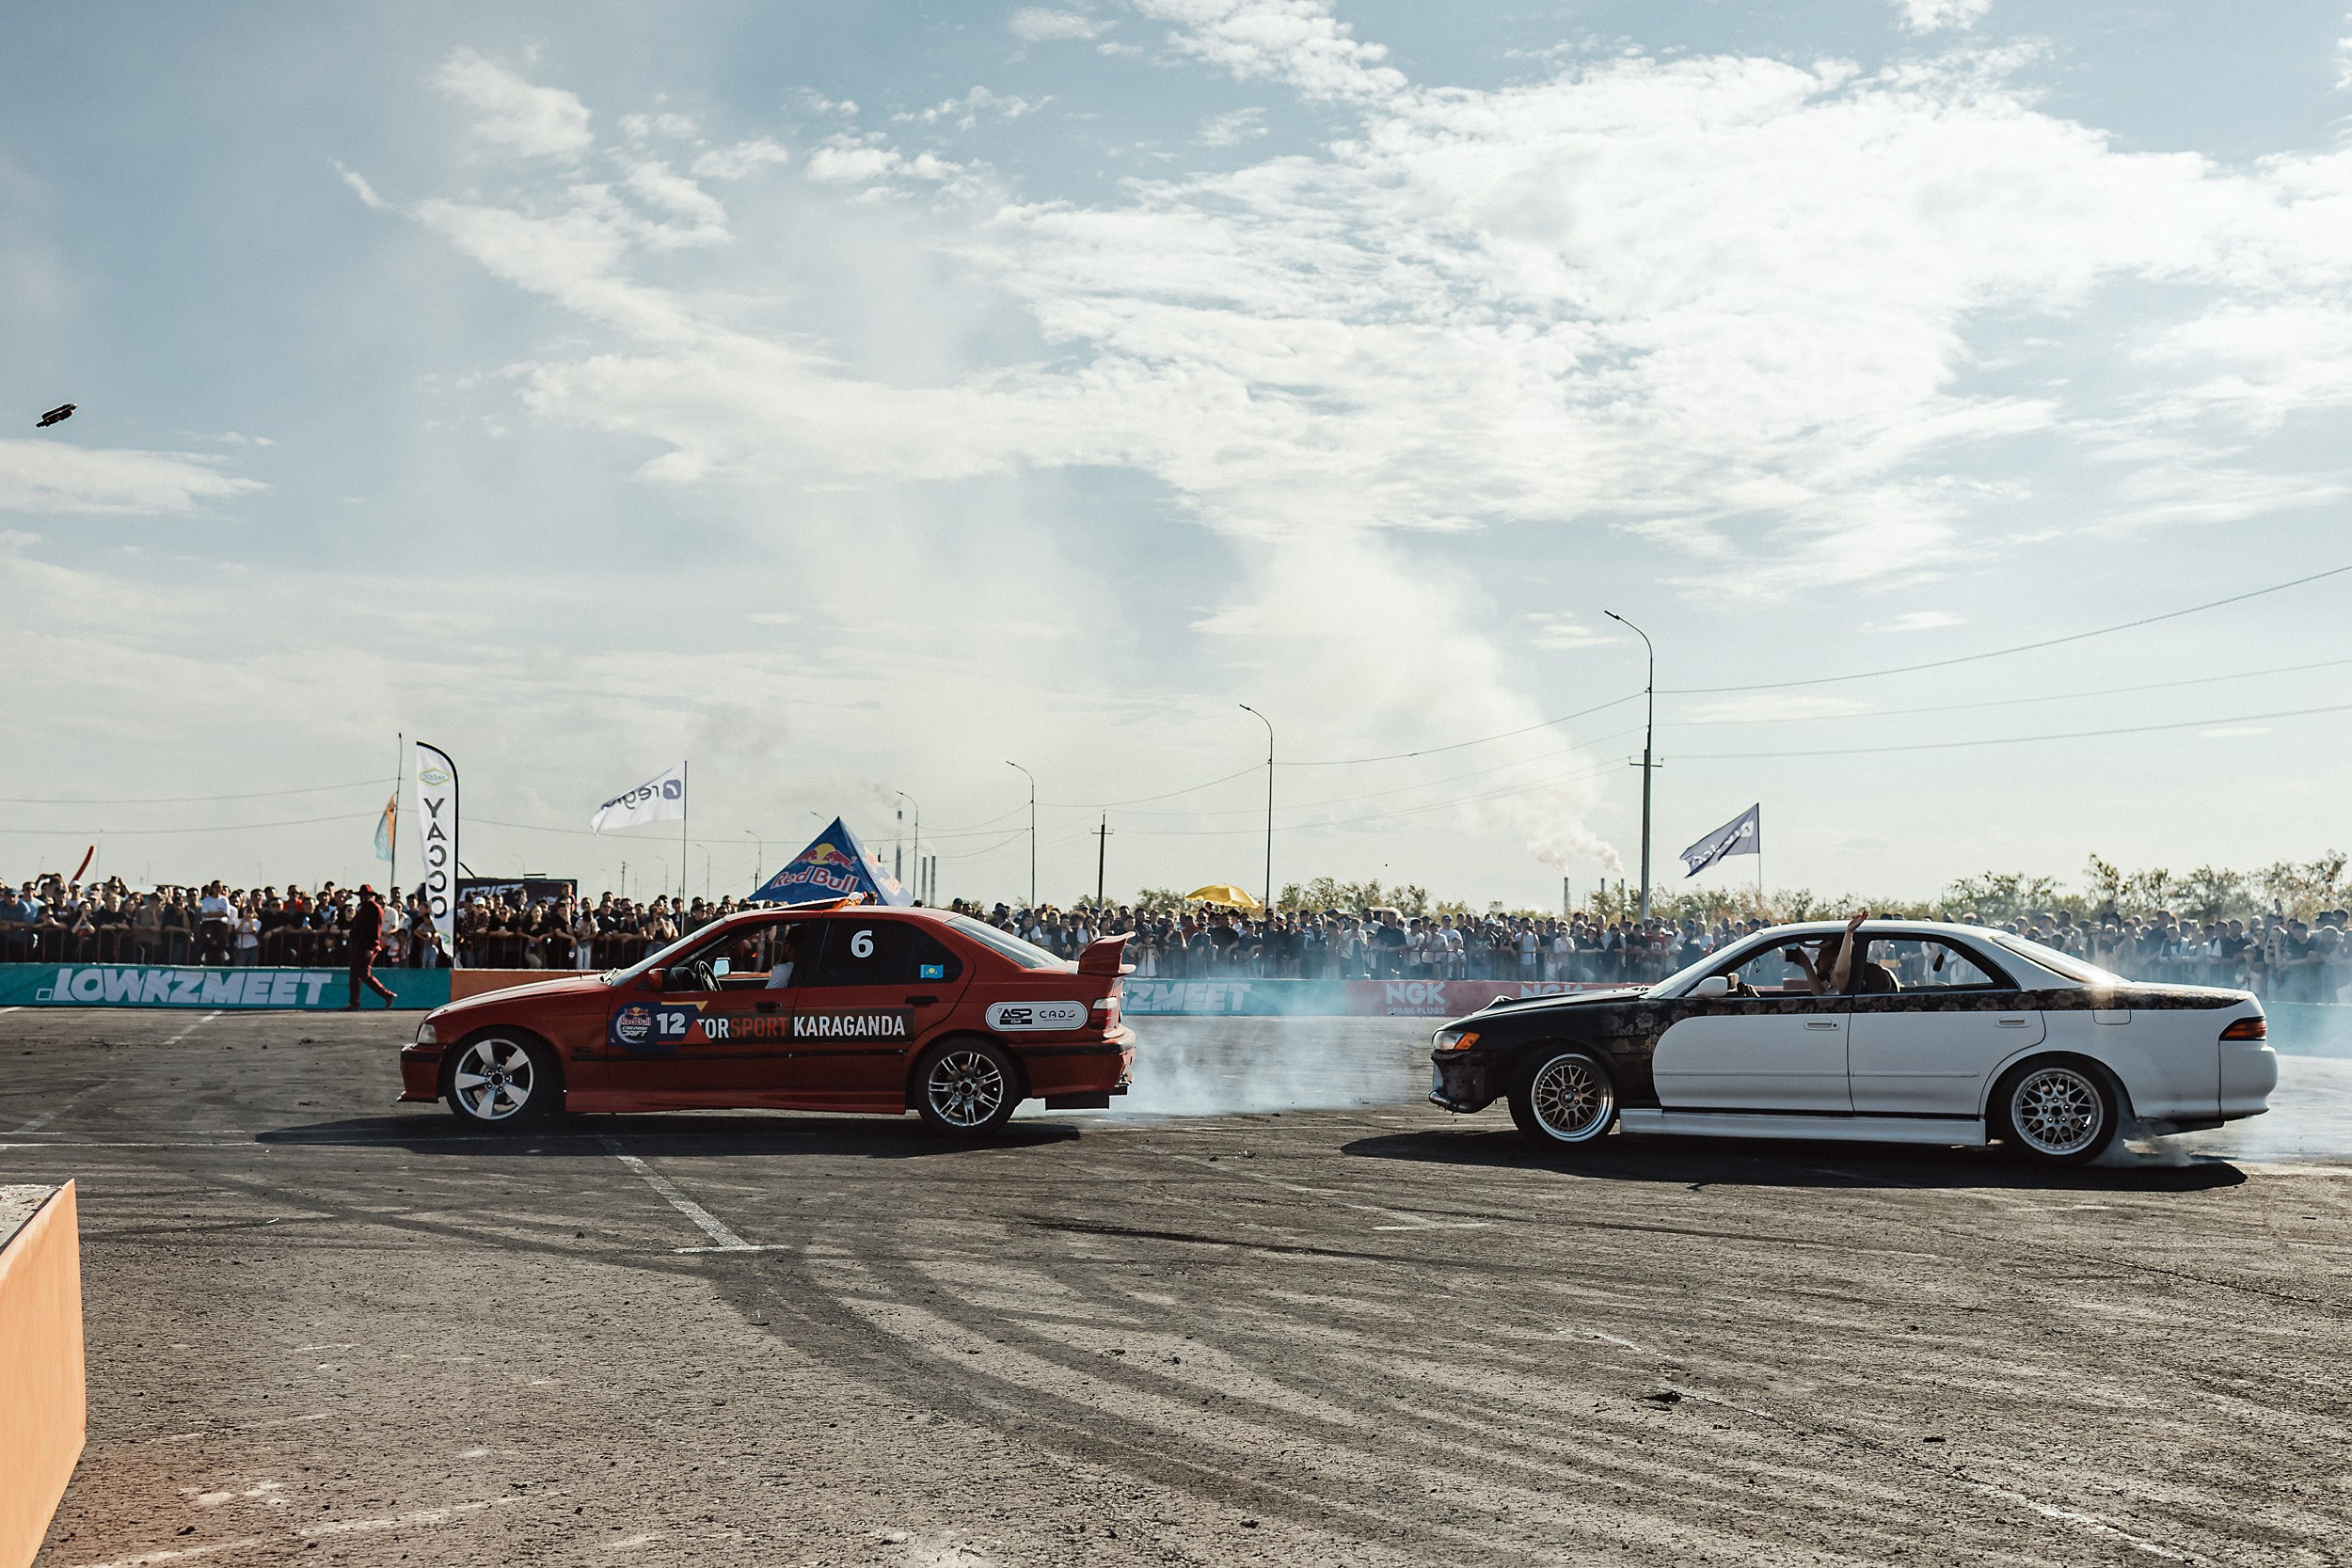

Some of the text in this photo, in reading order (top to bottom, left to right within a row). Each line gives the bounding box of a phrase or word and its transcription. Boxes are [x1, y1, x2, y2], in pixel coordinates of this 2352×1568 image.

[770, 866, 812, 890] Red
[810, 867, 860, 894] Bull
[850, 929, 874, 958] 6
[53, 969, 332, 1005] LOWKZMEET
[1386, 982, 1446, 1006] NGK
[621, 1017, 651, 1026] Red Bull
[1000, 1008, 1033, 1019] ASP
[1387, 1006, 1446, 1015] SPARK PLUGS
[657, 1012, 686, 1035] 12
[793, 1015, 906, 1037] KARAGANDA
